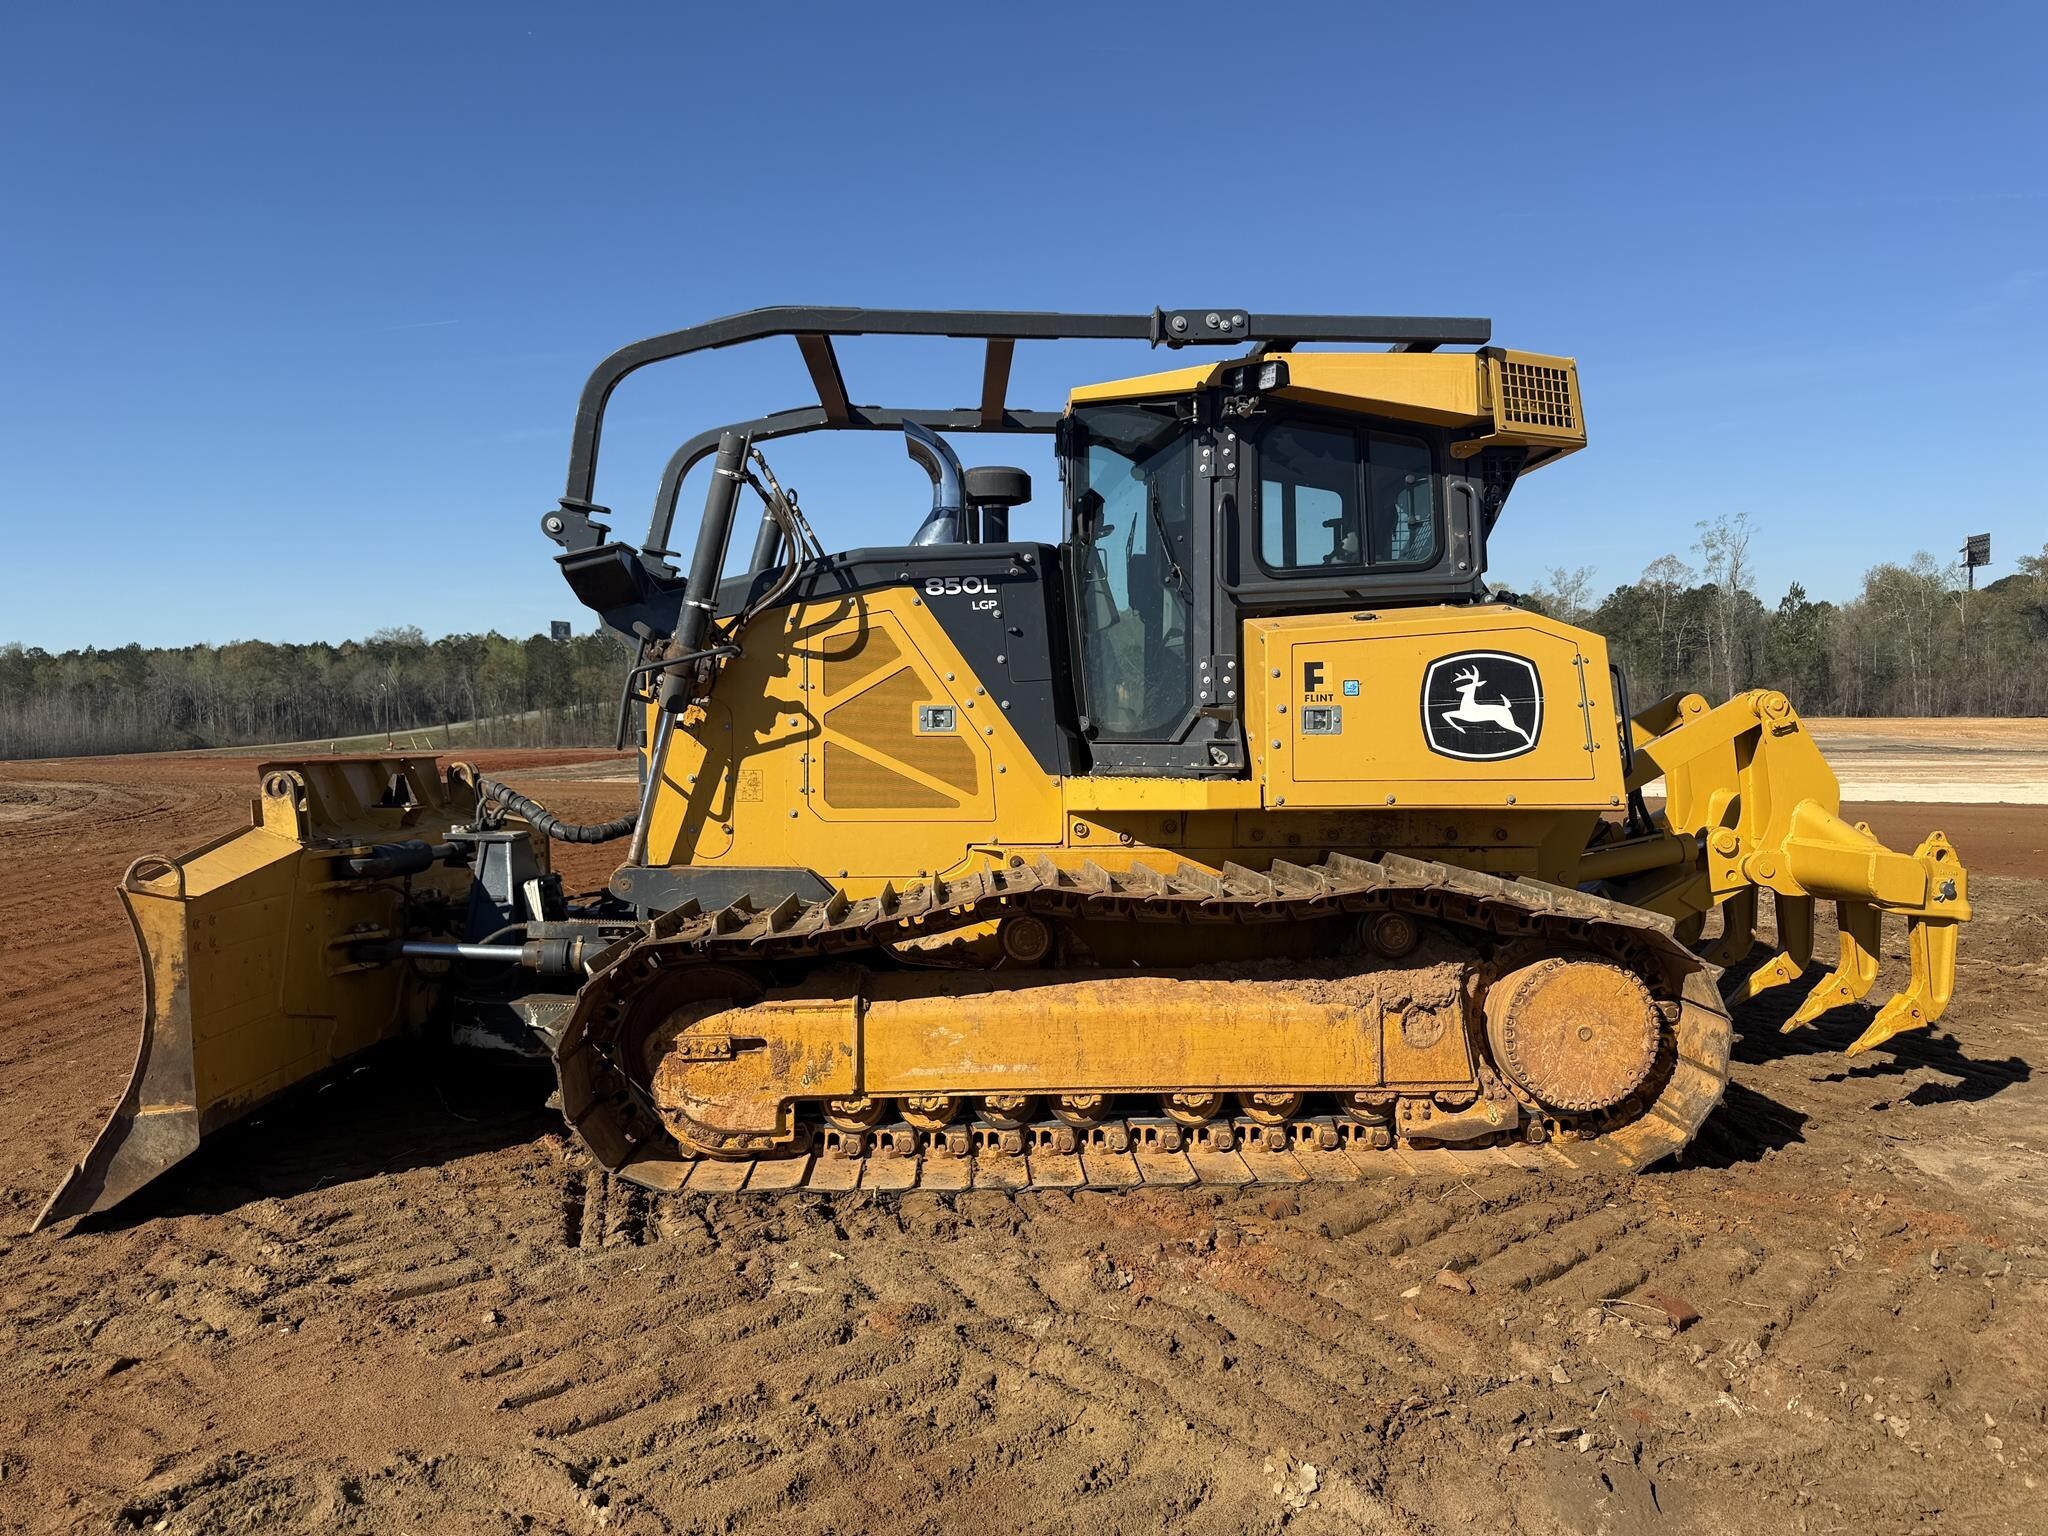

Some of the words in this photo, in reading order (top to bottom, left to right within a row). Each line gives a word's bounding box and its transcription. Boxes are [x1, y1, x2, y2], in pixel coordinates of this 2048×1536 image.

[925, 576, 997, 596] 850L
[971, 600, 998, 611] LGP
[1304, 661, 1324, 692] F
[1304, 694, 1334, 703] FLINT
